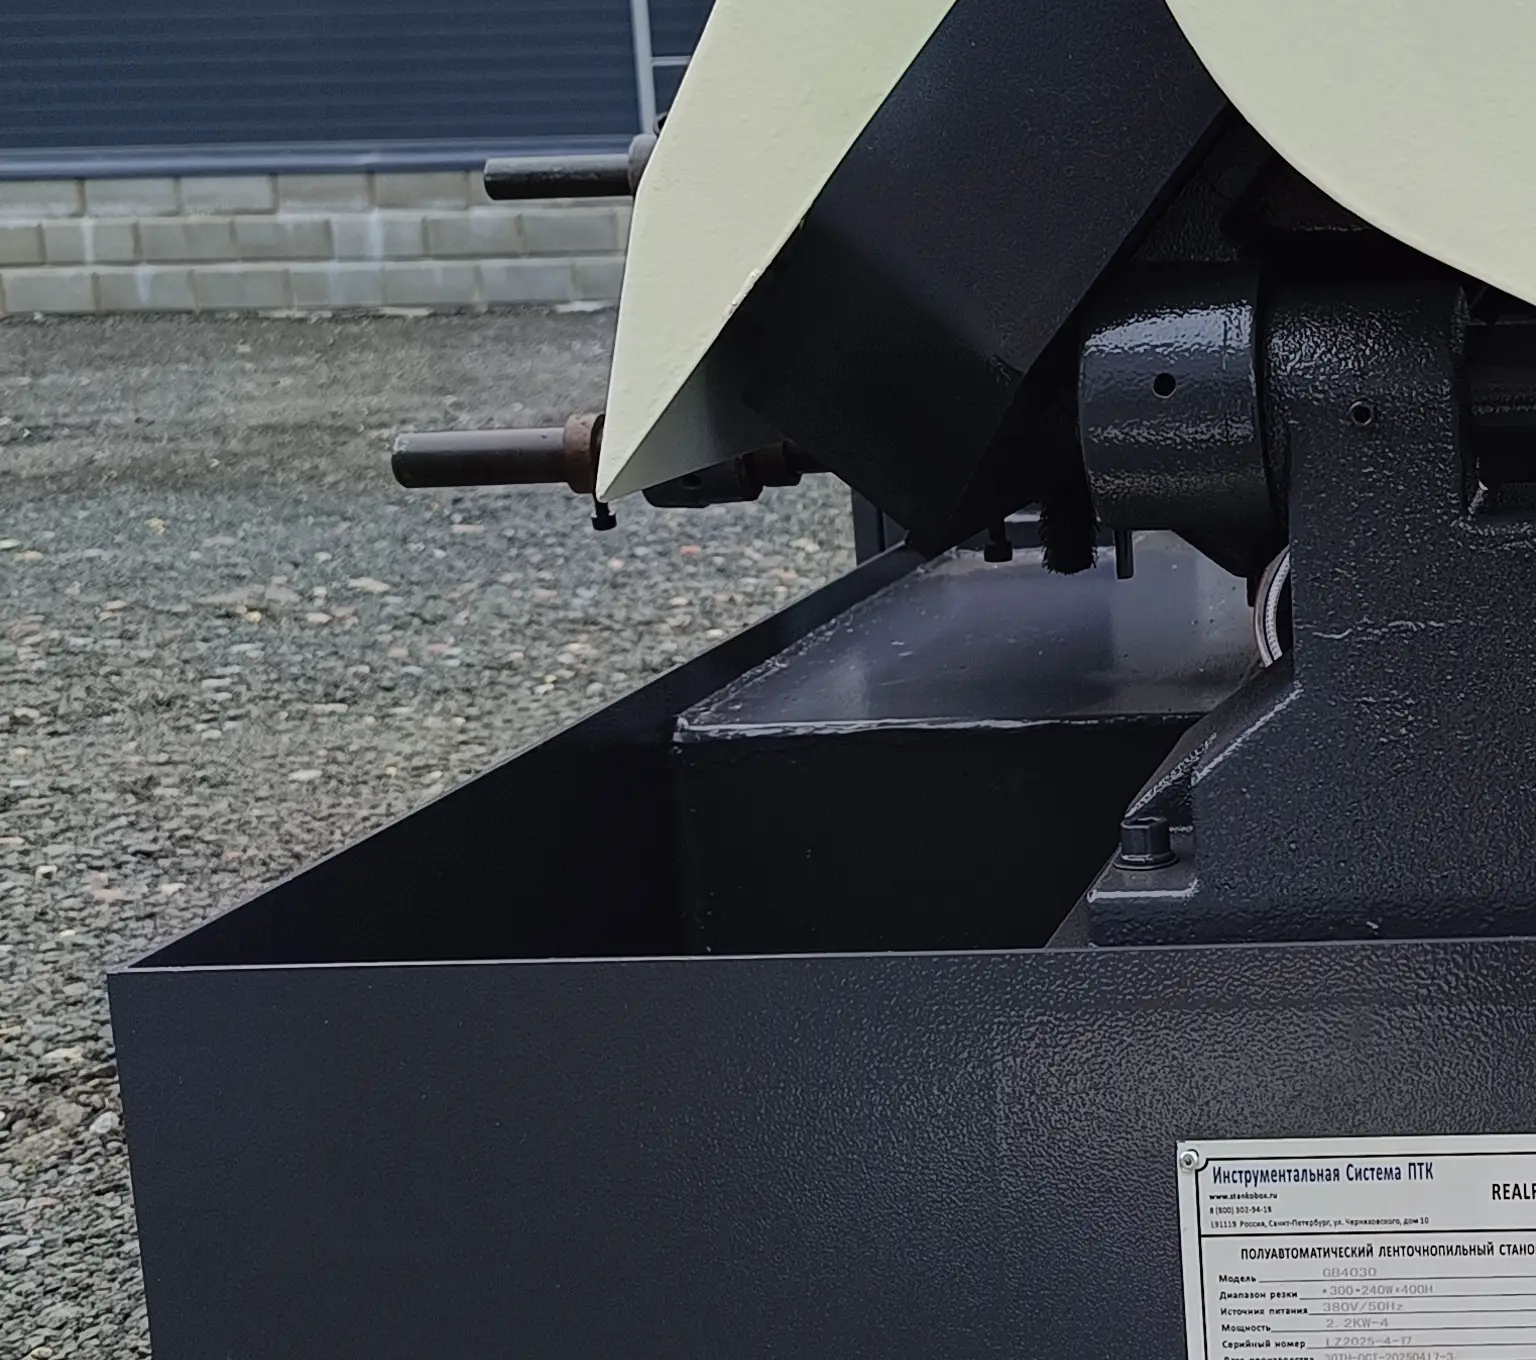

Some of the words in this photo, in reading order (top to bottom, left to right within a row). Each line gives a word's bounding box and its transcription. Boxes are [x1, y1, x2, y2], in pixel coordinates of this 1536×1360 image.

[1213, 1165, 1339, 1187] Инструментальная
[1346, 1164, 1401, 1182] Система
[1408, 1162, 1434, 1180] ПТК
[1404, 1218, 1418, 1226] дом
[1241, 1244, 1374, 1260] ПОЛУАВТОМАТИЧЕСКИЙ
[1378, 1241, 1494, 1258] ЛЕНТОЧНОПИЛЬНЫЙ
[1322, 1268, 1376, 1278] GB4030
[1219, 1275, 1256, 1284] Модель
[1219, 1292, 1266, 1300] Диапазон
[1270, 1291, 1298, 1300] резки
[1269, 1307, 1308, 1315] питания
[1323, 1301, 1403, 1312] 380V/50Hz
[1222, 1324, 1271, 1333] Мощность
[1222, 1340, 1270, 1349] Серийный
[1275, 1340, 1306, 1349] номер
